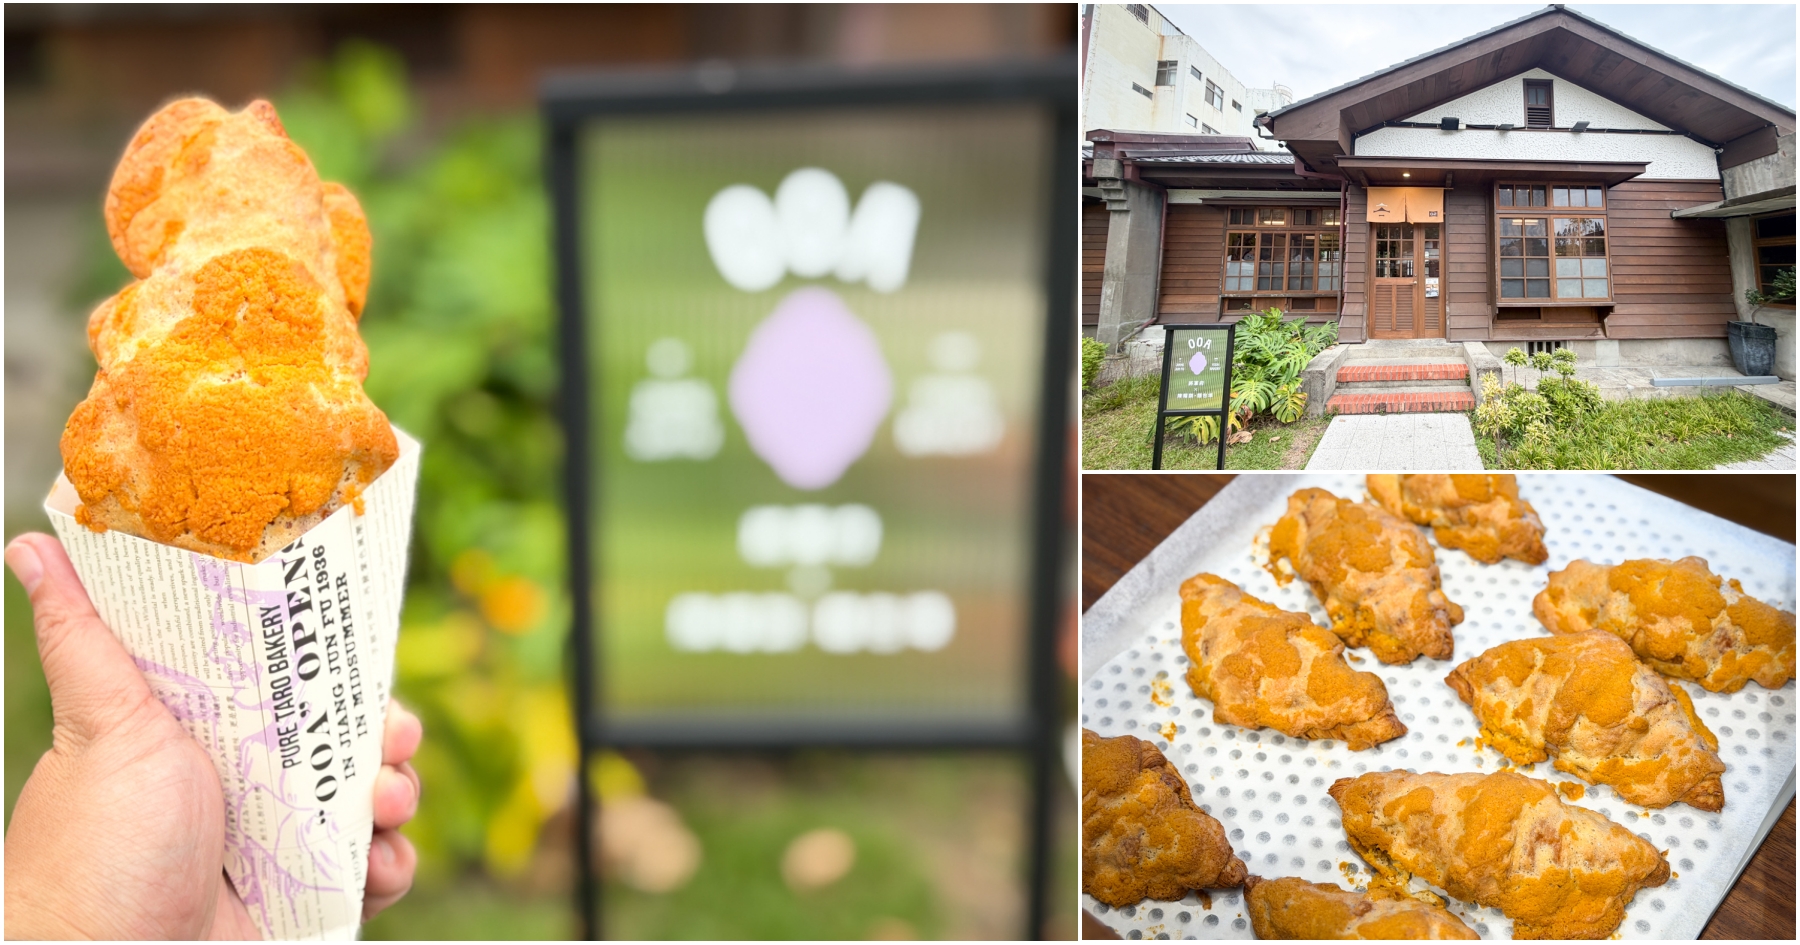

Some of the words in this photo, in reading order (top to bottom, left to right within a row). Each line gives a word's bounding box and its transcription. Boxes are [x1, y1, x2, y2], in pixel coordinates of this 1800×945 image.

[1188, 337, 1212, 350] OOA
[106, 565, 115, 586] special
[133, 554, 144, 576] quality
[177, 558, 183, 567] of
[178, 568, 187, 585] spark
[311, 543, 330, 591] 1936
[116, 564, 127, 596] impressive
[137, 577, 147, 603] excellent
[168, 573, 181, 612] perspectives,
[141, 604, 149, 621] With
[152, 601, 160, 626] material
[192, 587, 201, 619] traditional
[203, 594, 211, 607] only
[216, 593, 225, 625] worldwide
[319, 598, 335, 628] FU
[174, 614, 185, 641] youthful
[184, 606, 194, 638] combined,
[209, 622, 217, 639] point
[228, 603, 237, 632] industrial
[199, 636, 208, 658] ignited
[221, 632, 231, 656] popular
[259, 603, 289, 672] BAKERY
[334, 571, 364, 708] MIDSUMMER
[168, 642, 178, 676] anticipated
[191, 650, 200, 678] creativity
[211, 641, 220, 664] starting
[234, 644, 246, 680] opportunity
[324, 634, 342, 675] JUN
[225, 663, 233, 680] flavor
[269, 675, 296, 721] TARO
[331, 682, 352, 748] JIANG
[354, 713, 368, 737] IN
[276, 722, 302, 769] PURE
[299, 699, 343, 824] “OOA”
[341, 755, 356, 780] IN
